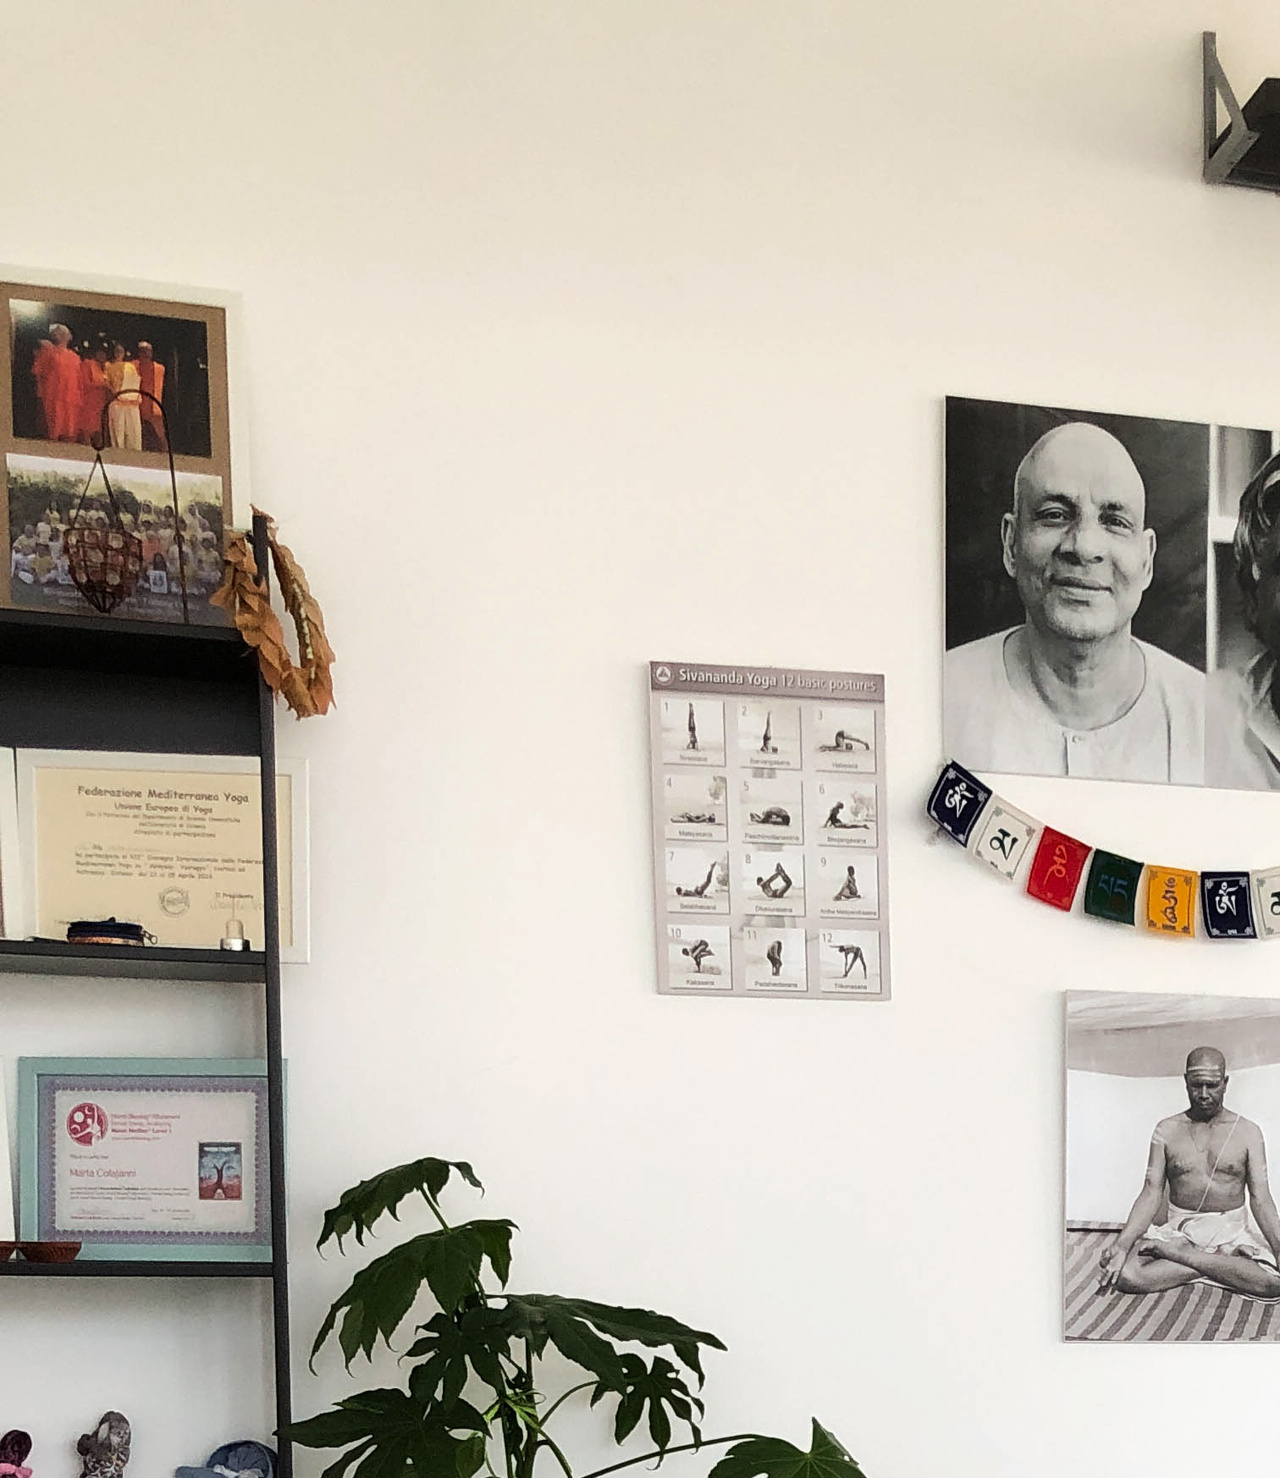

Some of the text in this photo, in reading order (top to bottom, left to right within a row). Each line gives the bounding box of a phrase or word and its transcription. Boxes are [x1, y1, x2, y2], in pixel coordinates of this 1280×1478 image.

[678, 668, 877, 692] Sivananda Yoga 12 basic postures
[741, 706, 747, 716] 2
[818, 710, 823, 720] 3
[666, 779, 672, 788] 4
[744, 782, 750, 791] 5
[819, 785, 825, 794] 6
[77, 785, 142, 799] Federazione
[223, 792, 250, 805] Yoga
[193, 805, 213, 815] Yoga
[669, 851, 675, 861] 7
[745, 854, 751, 864] 8
[820, 857, 827, 867] 9
[670, 928, 682, 938] 10
[747, 931, 757, 940] 11
[822, 933, 833, 943] 12
[70, 1168, 94, 1177] Marta
